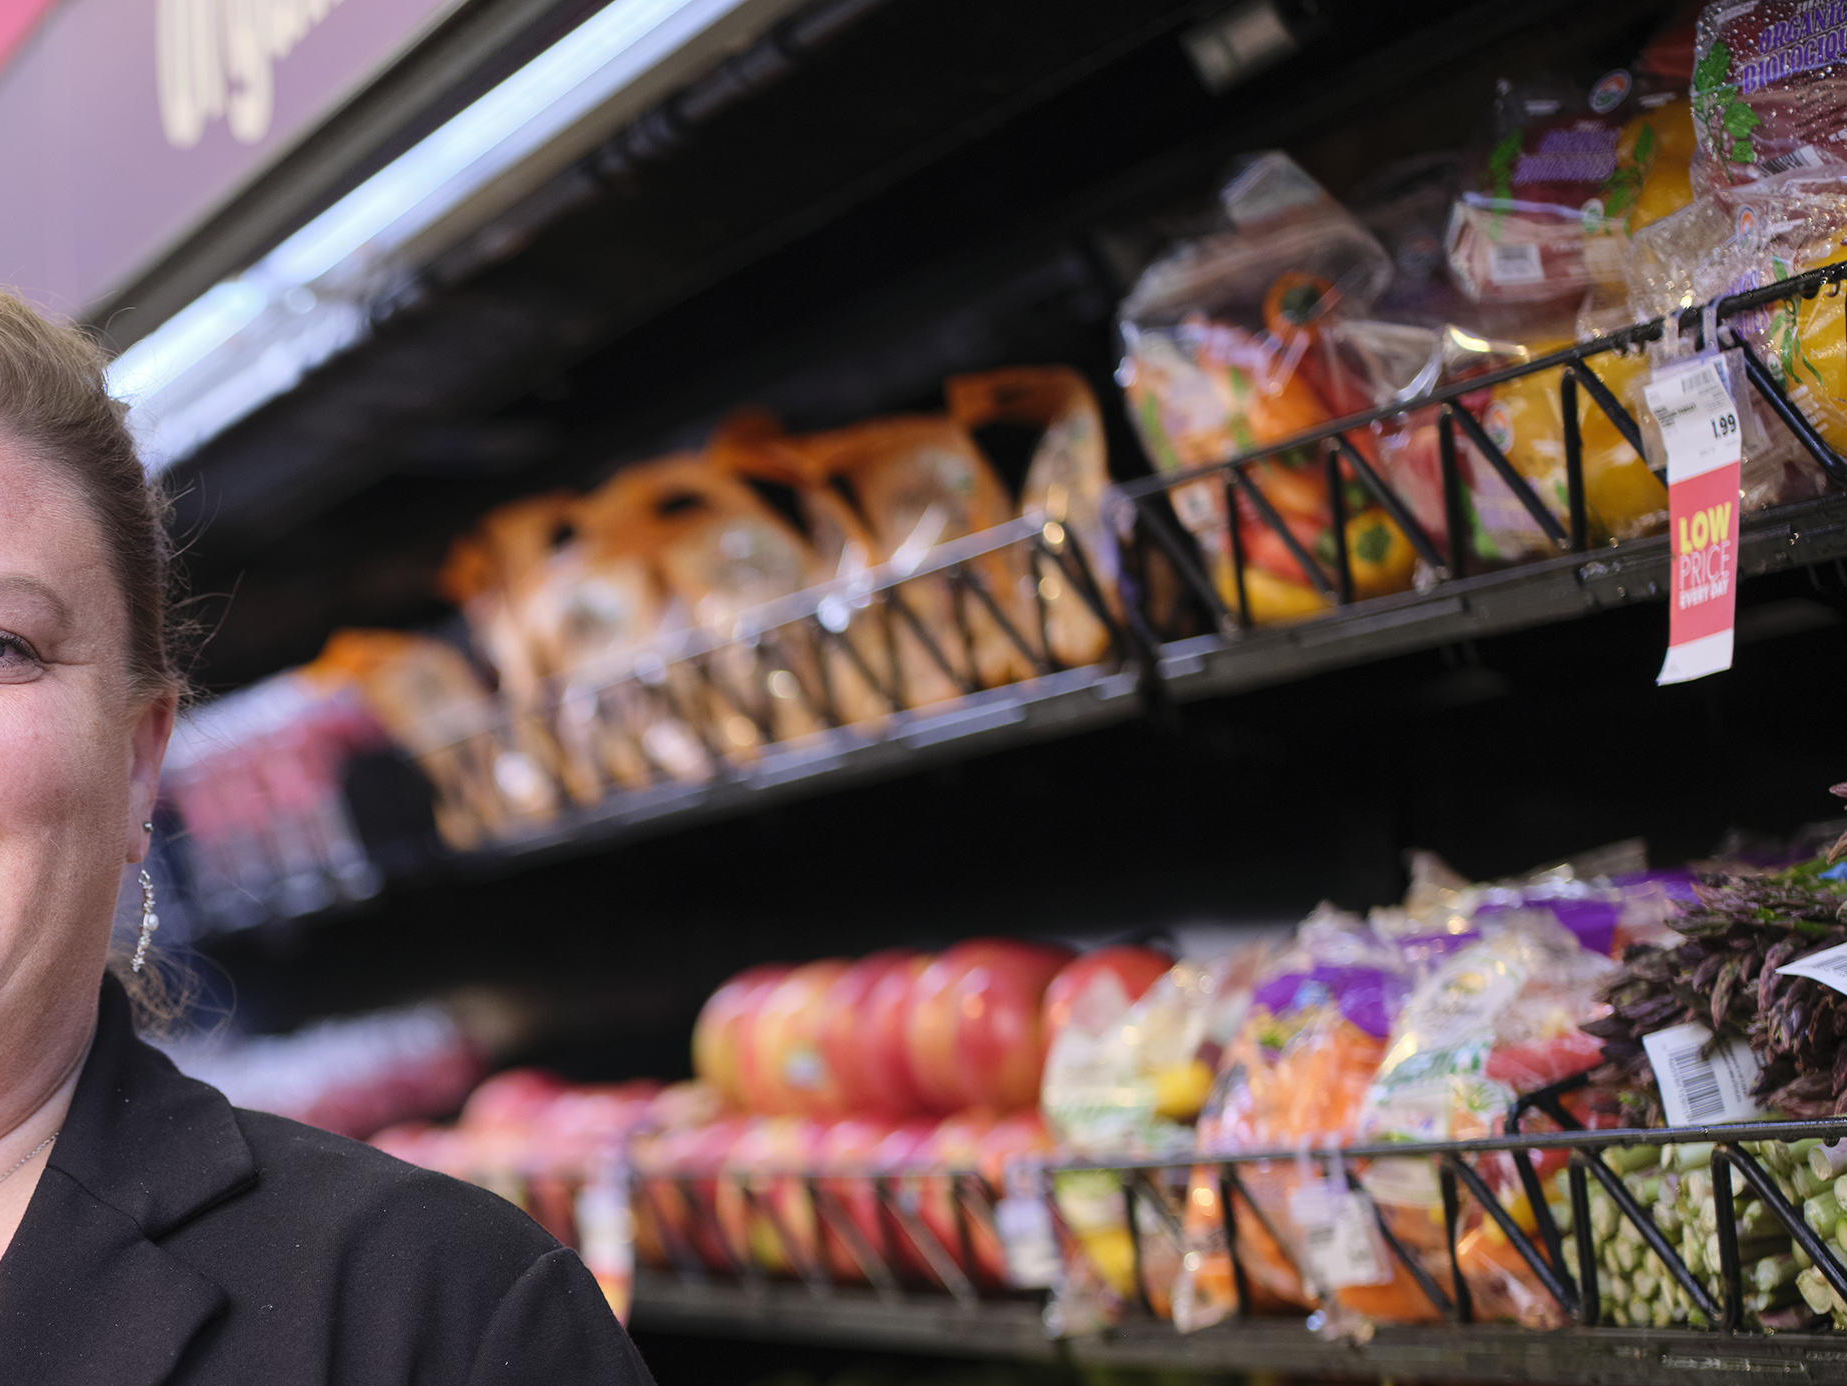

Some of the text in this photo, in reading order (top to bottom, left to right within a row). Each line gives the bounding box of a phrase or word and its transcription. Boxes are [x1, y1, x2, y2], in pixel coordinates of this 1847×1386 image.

[1759, 0, 1847, 53] ORGANIC
[1711, 413, 1737, 439] 1.99
[1678, 500, 1731, 555] LOW
[1679, 540, 1730, 590] PRICE
[1679, 578, 1729, 610] EVERY DAY
